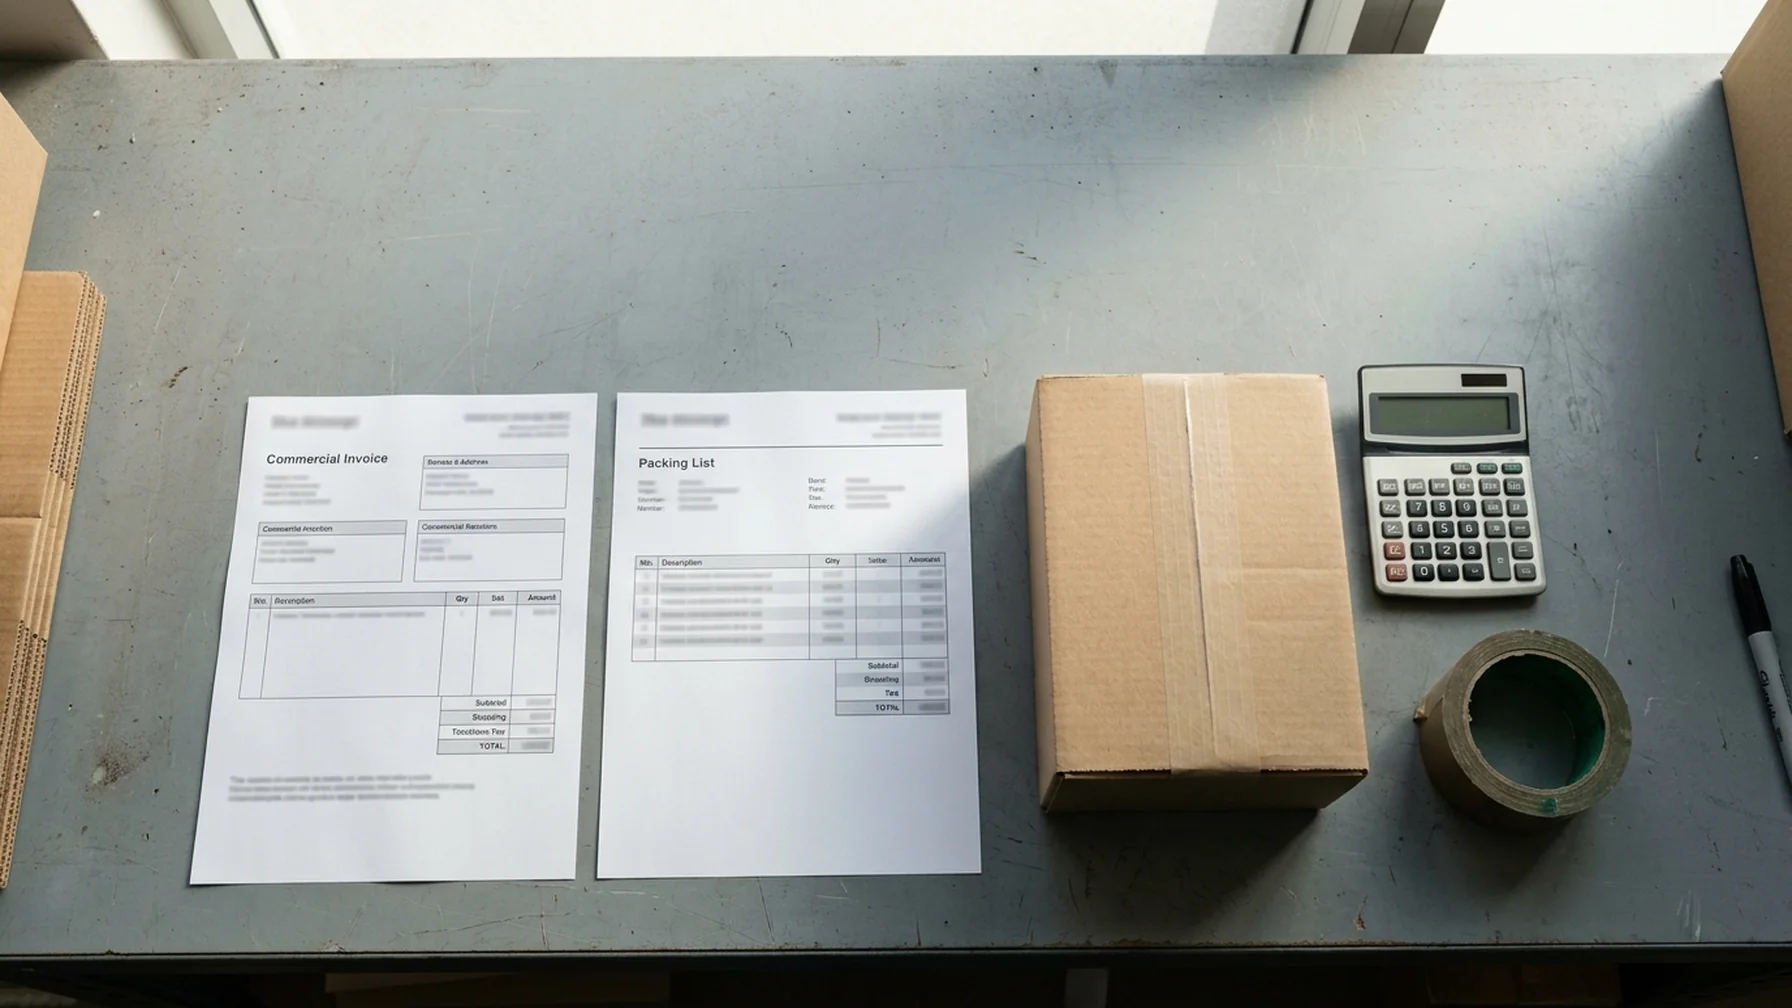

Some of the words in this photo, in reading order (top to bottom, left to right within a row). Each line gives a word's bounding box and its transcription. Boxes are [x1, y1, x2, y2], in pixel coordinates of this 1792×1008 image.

[267, 454, 341, 464] Commercial
[344, 453, 388, 464] Invoice
[639, 458, 688, 470] Packing
[692, 458, 715, 468] List
[1415, 502, 1422, 511] 7
[1439, 502, 1446, 511] 8
[1465, 524, 1473, 533] 6
[1442, 545, 1451, 555] 2
[1468, 545, 1476, 555] 3
[1420, 566, 1428, 576] 0
